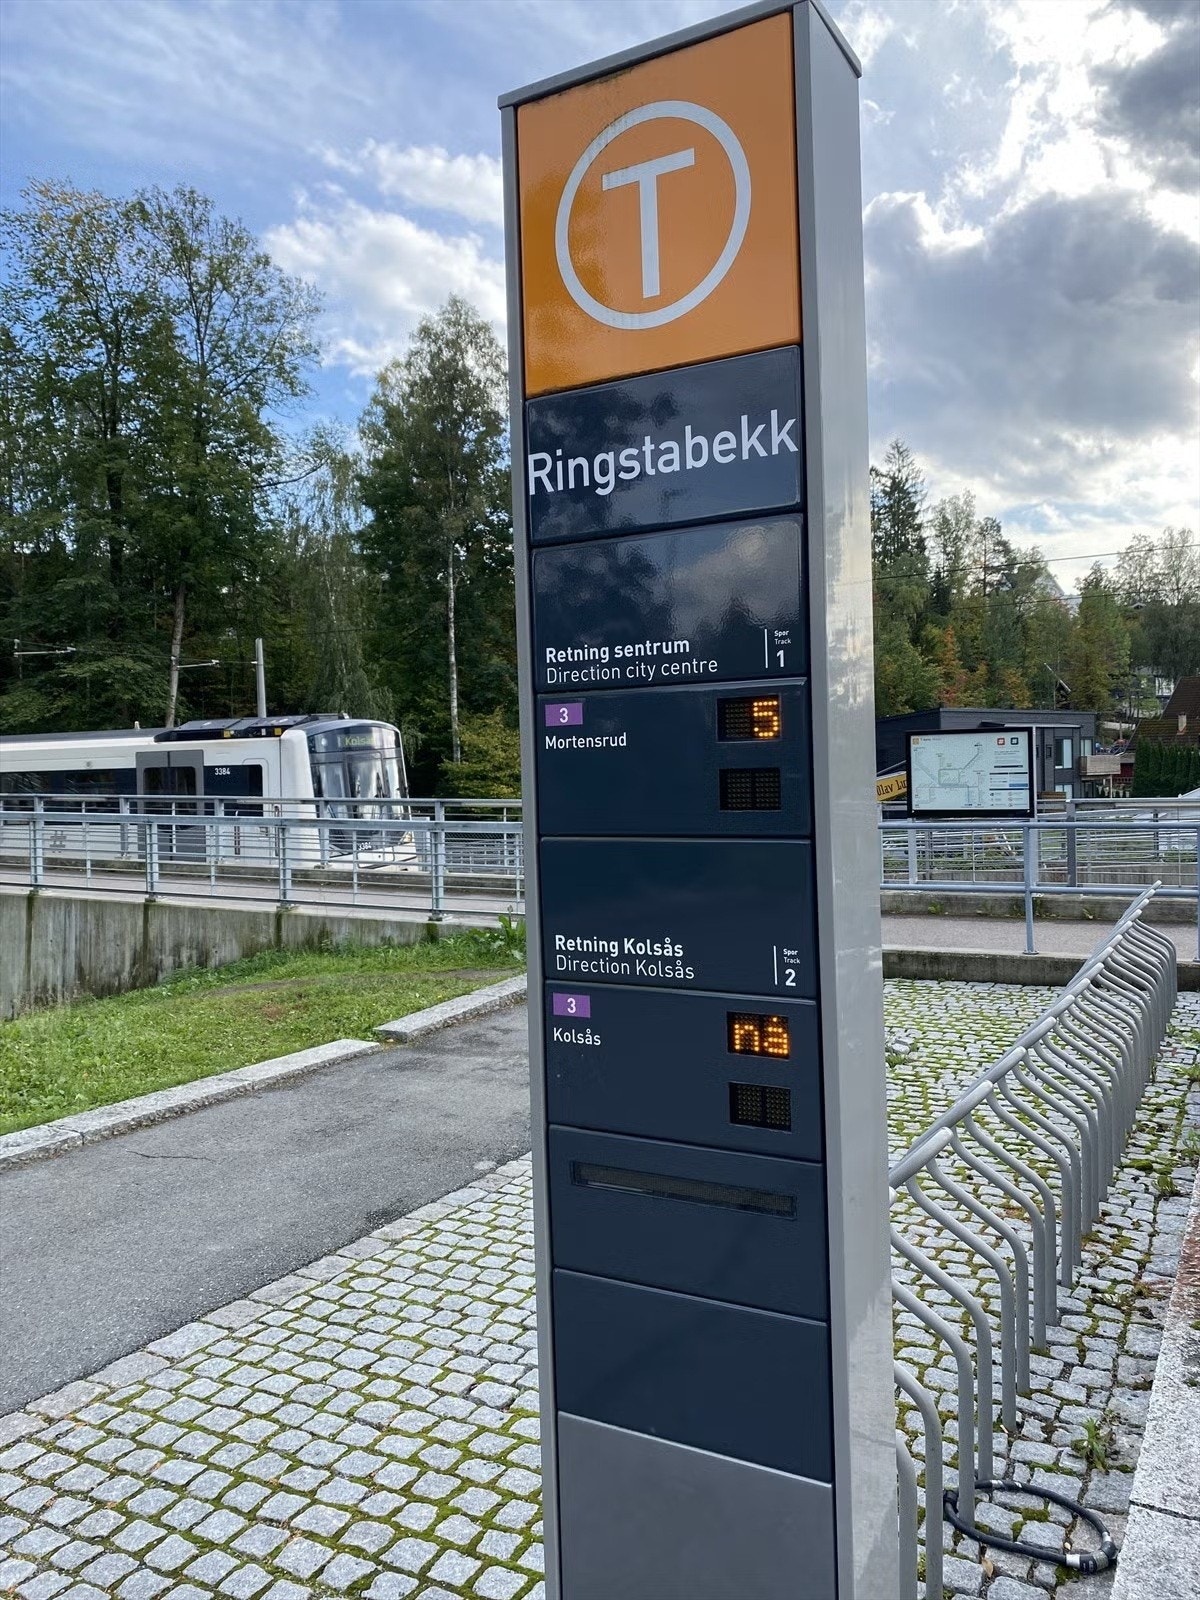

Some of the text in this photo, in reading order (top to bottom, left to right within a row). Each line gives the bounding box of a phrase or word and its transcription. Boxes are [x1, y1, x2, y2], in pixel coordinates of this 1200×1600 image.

[602, 147, 695, 299] T
[528, 409, 799, 496] Ringstabekk
[546, 639, 690, 663] Retning sentrum
[776, 650, 784, 667] 1
[547, 657, 718, 684] Direction city centre
[559, 707, 569, 723] 3
[753, 700, 779, 738] 5
[545, 732, 627, 750] Mortensrud
[555, 934, 684, 958] Retning Kolsås
[783, 948, 799, 956] Spor
[556, 954, 695, 979] Direction Kolsås
[783, 956, 801, 964] Track
[785, 968, 796, 986] 2
[567, 997, 577, 1014] 3
[553, 1027, 601, 1046] Kolsås
